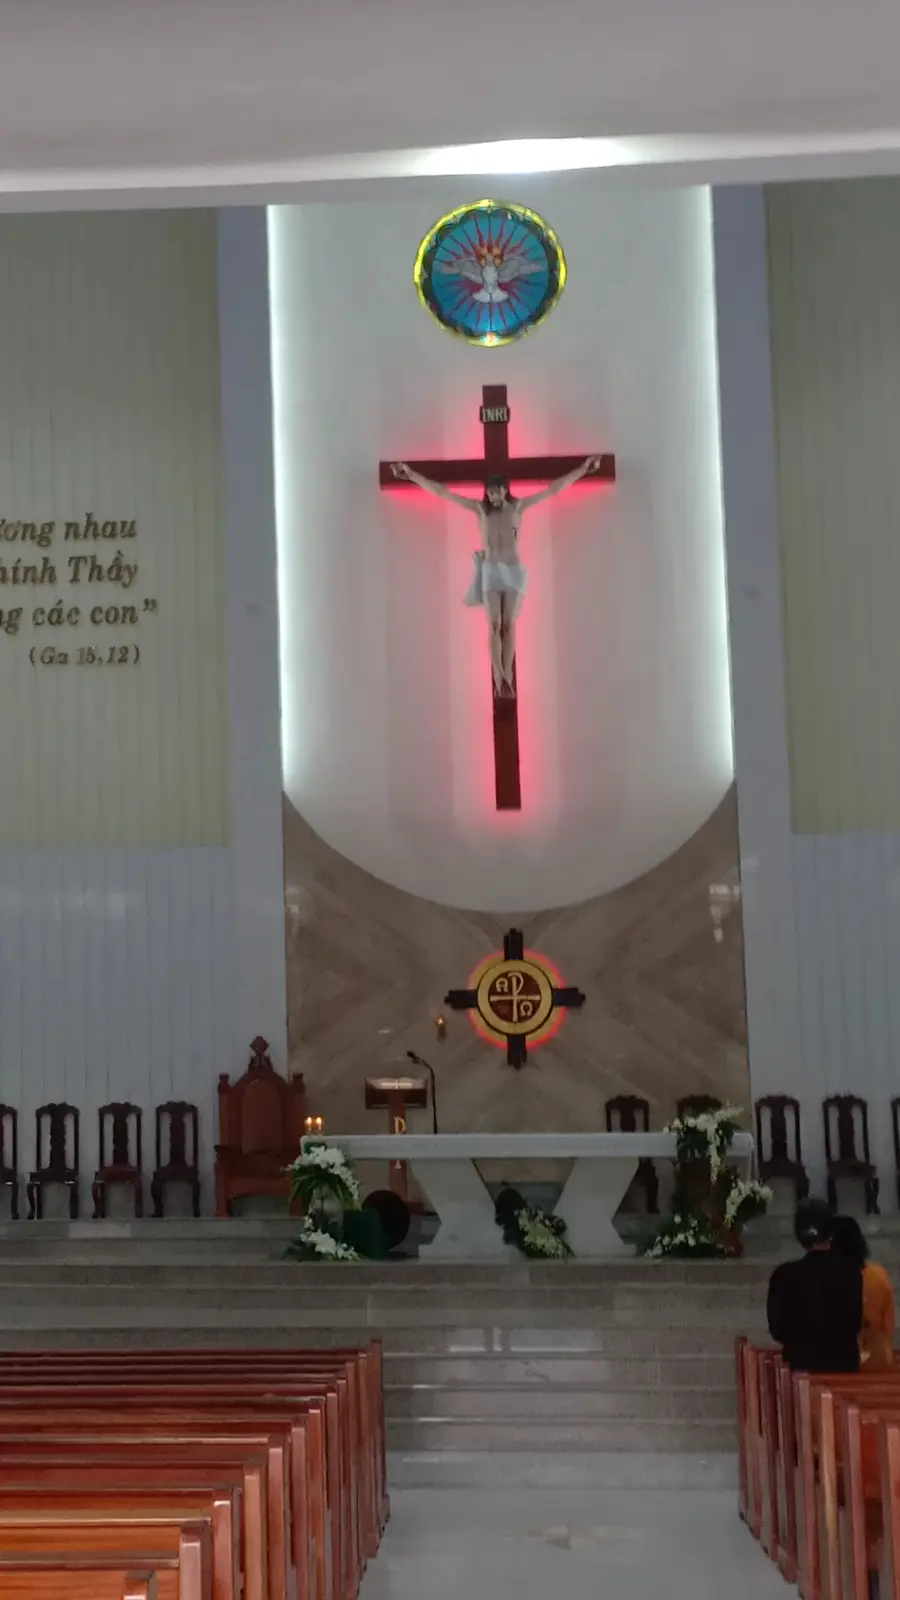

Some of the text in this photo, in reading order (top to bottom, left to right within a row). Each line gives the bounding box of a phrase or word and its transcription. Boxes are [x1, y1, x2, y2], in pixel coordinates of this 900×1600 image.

[482, 407, 508, 422] INRI
[64, 512, 137, 542] nhau
[68, 550, 138, 589] Thầy
[0, 606, 23, 635] g
[32, 599, 80, 627] các
